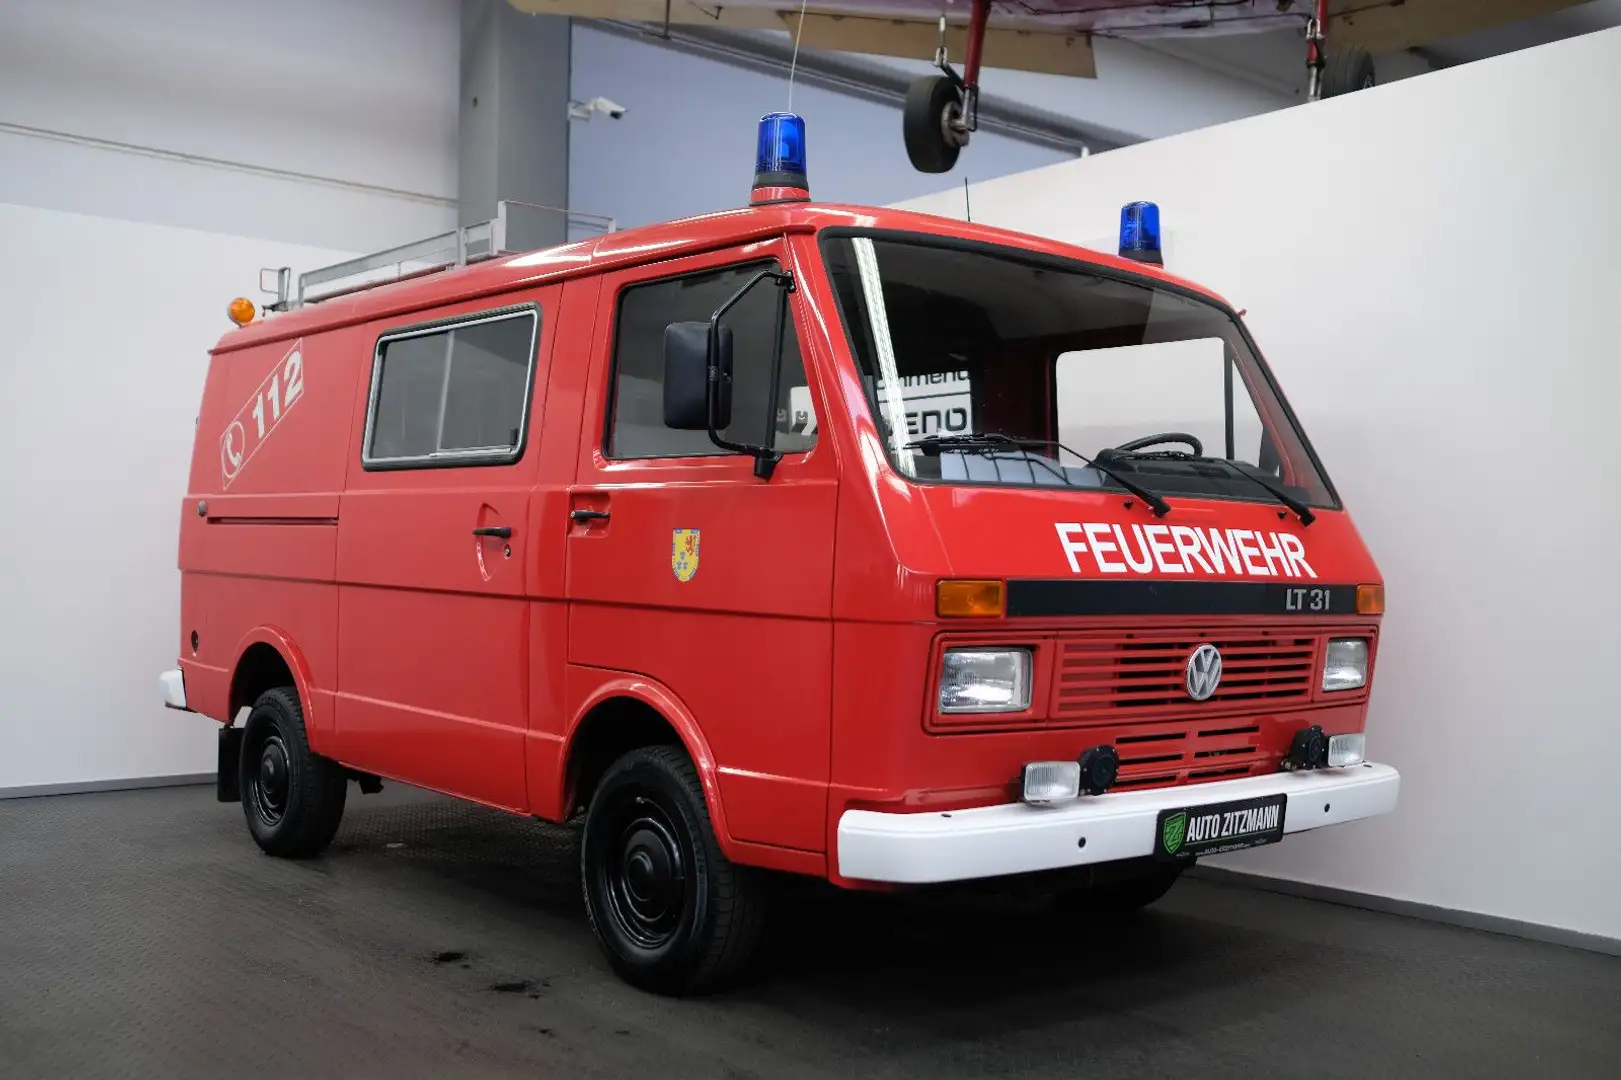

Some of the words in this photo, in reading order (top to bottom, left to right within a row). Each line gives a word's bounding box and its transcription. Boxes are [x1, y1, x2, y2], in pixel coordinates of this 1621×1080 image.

[252, 350, 303, 439] 112
[1054, 522, 1318, 578] FEUERWEHR
[1286, 589, 1306, 611] LT
[1310, 589, 1331, 611] 31
[1187, 814, 1220, 842] AUTO
[1221, 804, 1279, 836] ZITZMANN
